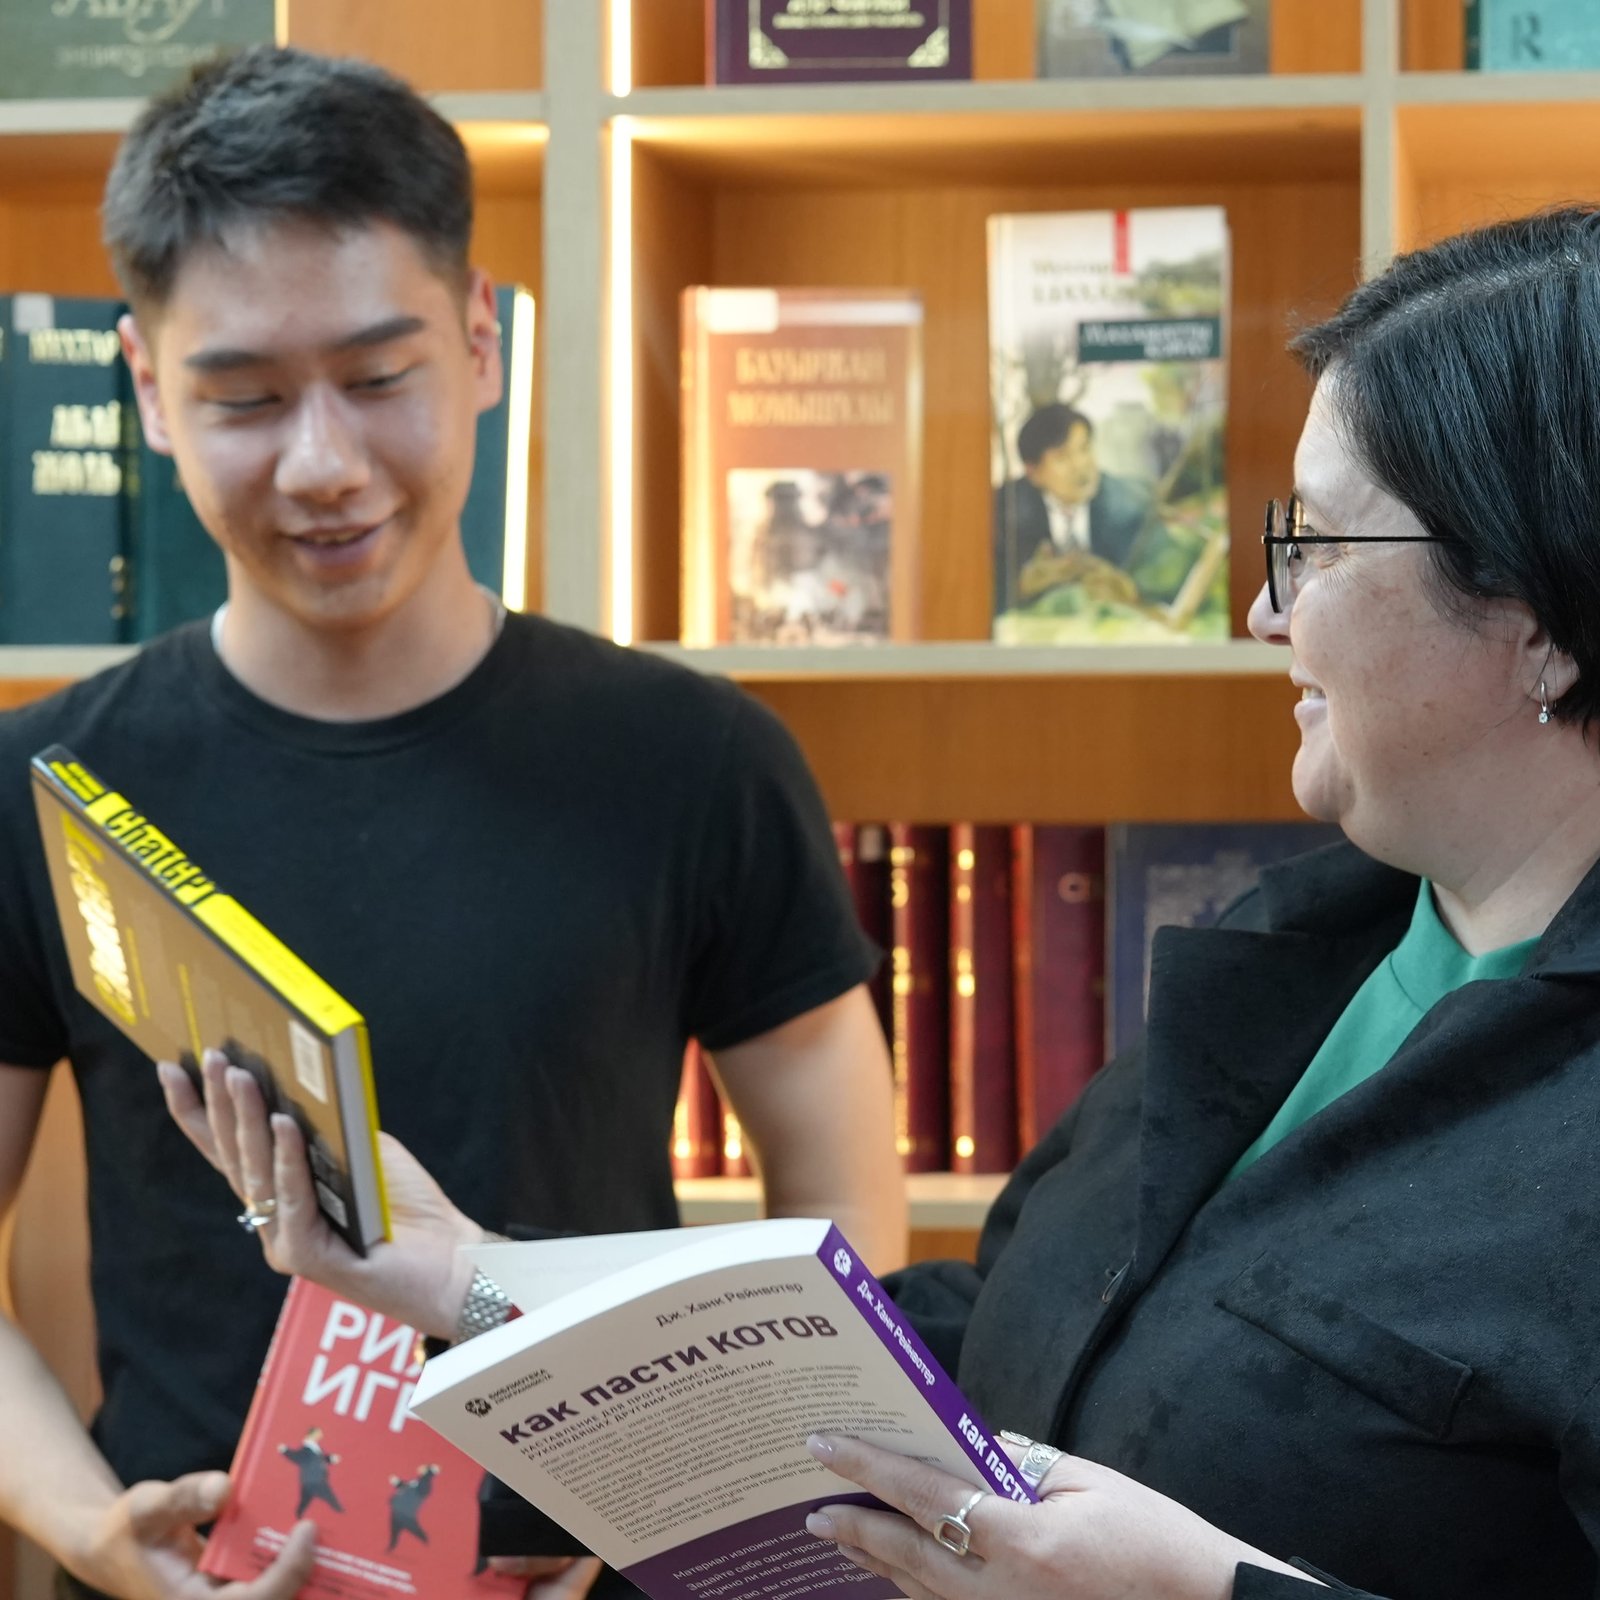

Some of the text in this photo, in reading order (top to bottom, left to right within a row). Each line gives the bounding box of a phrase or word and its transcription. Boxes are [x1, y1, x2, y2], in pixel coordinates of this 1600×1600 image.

[655, 1281, 803, 1328] Дж. Ханк Рейнвотер
[874, 1299, 895, 1333] Ханк
[893, 1325, 935, 1386] Рейнвотер
[499, 1314, 839, 1445] как пасти КОТОВ
[520, 1414, 599, 1455] НАСТАВЛЕНИЕ
[601, 1401, 625, 1419] ДЛЯ
[528, 1360, 775, 1461] РУКОВОДЯЩИХ ДРУГИМИ ПРОГРАММИСТАМИ
[957, 1412, 989, 1457] как
[672, 1528, 809, 1580] Материал изложен комп
[686, 1570, 735, 1591] Задайте
[735, 1560, 762, 1573] себе
[762, 1550, 793, 1563] один
[744, 1574, 760, 1583] ли
[759, 1566, 782, 1577] мне
[762, 1583, 780, 1593] вы
[780, 1568, 831, 1587] ответите:
[812, 1577, 845, 1590] книга
